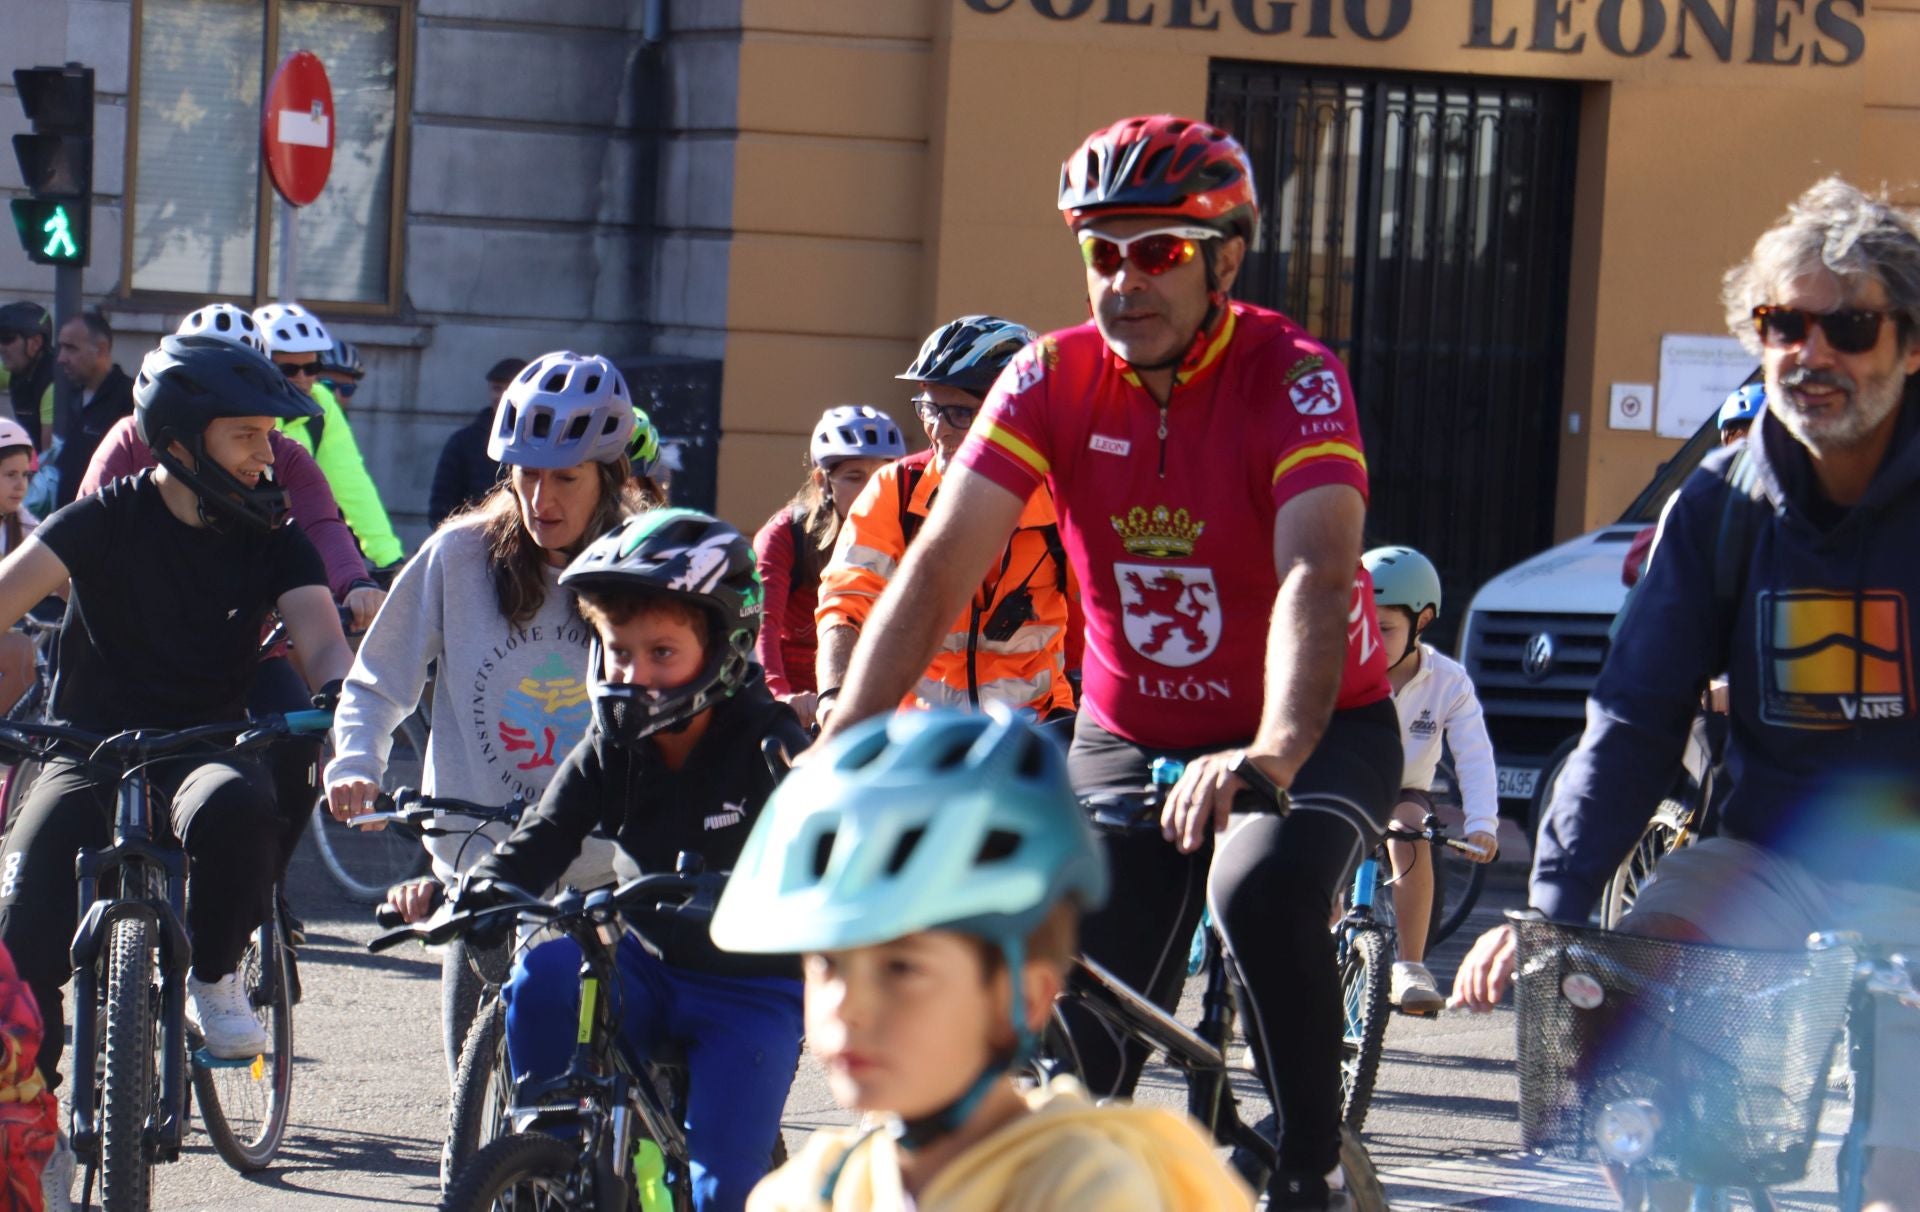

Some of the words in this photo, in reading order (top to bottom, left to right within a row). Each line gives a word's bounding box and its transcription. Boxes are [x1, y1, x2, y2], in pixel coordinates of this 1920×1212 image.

[962, 0, 1411, 41] EGIO
[1459, 0, 1866, 67] LEONES
[473, 659, 497, 763] INSTINCTS
[493, 626, 543, 659] LOVE
[1138, 675, 1231, 701] LEÓN
[1838, 696, 1904, 720] VANS
